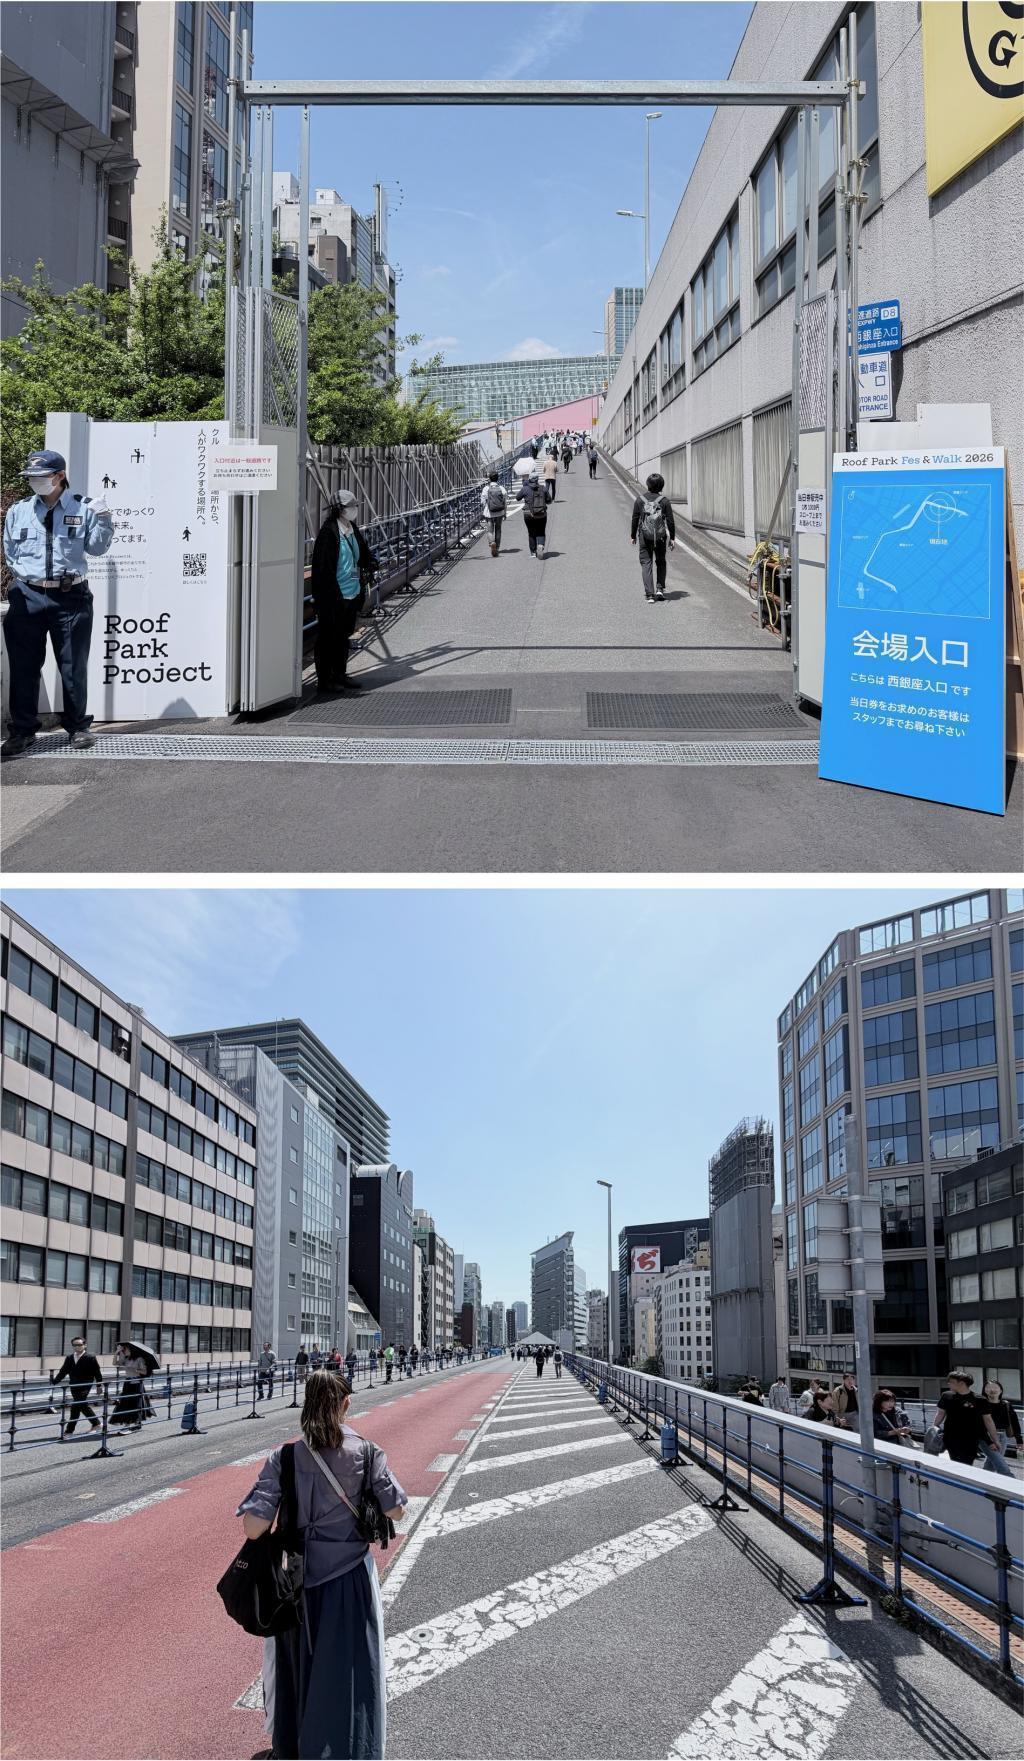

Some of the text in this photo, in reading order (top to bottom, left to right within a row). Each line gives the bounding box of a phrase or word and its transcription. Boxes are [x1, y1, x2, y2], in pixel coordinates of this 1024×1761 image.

[858, 308, 879, 320] 速道路
[882, 308, 896, 318] D8
[860, 361, 887, 374] 動車道
[859, 394, 888, 404] TOR ROAD
[841, 453, 994, 466] Roof Park Fes & Walk 2026
[104, 612, 171, 634] Roof
[104, 638, 168, 660] Park
[852, 630, 969, 668] 会場入口
[102, 662, 212, 684] Project
[850, 672, 971, 696] こちらは 西銀座入口 です
[850, 696, 970, 723] 当日券をお求めのお客様は
[852, 712, 966, 738] スタッフまでお尋ね下さい
